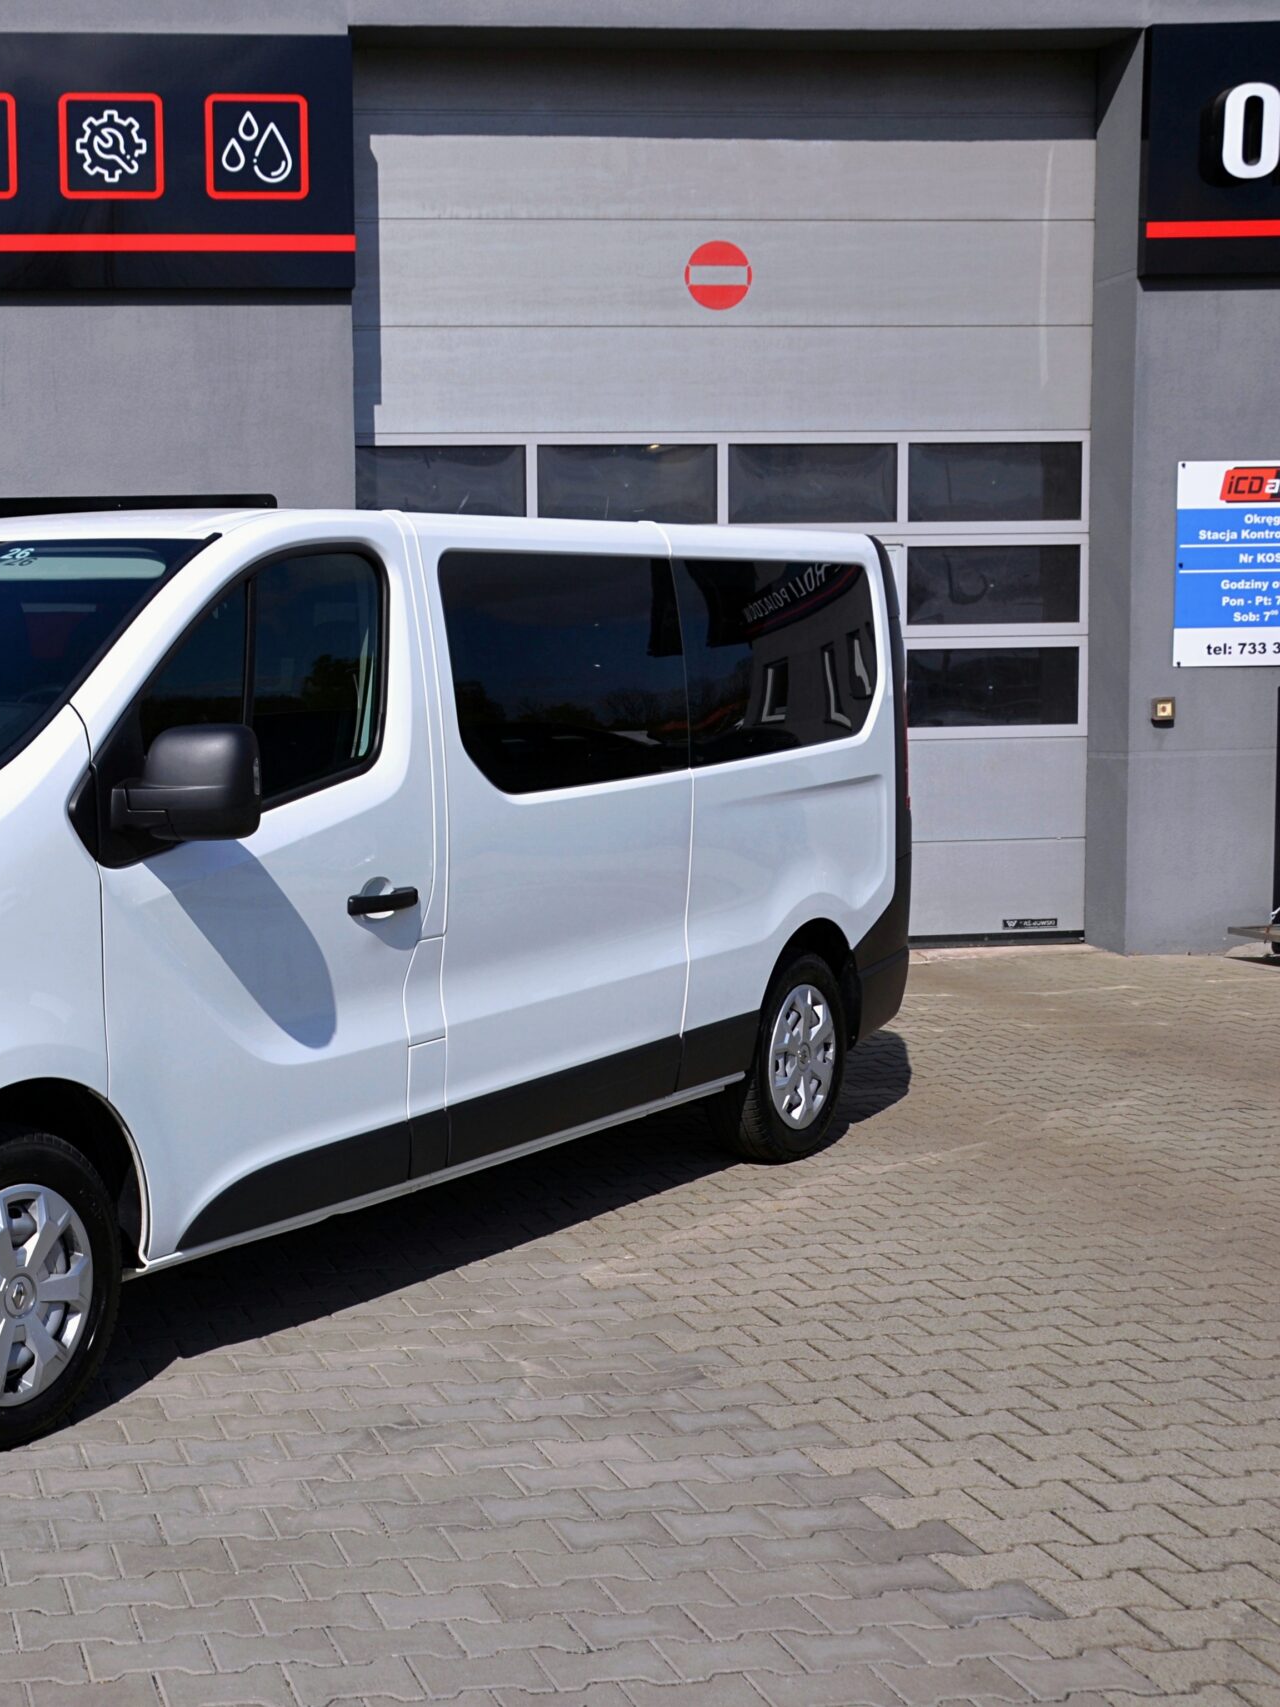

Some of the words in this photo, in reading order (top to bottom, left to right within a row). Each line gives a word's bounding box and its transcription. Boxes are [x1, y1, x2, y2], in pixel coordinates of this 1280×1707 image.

[1198, 529, 1238, 542] Stacja
[1241, 529, 1280, 540] Kontro
[0, 547, 35, 559] 26
[1239, 552, 1253, 563] Nr
[1221, 579, 1269, 591] Godziny
[1222, 596, 1245, 606] Pon
[1255, 595, 1272, 606] Pt:
[1233, 611, 1260, 622] Sob:
[1207, 643, 1232, 655] tel:
[1238, 642, 1267, 655] 733
